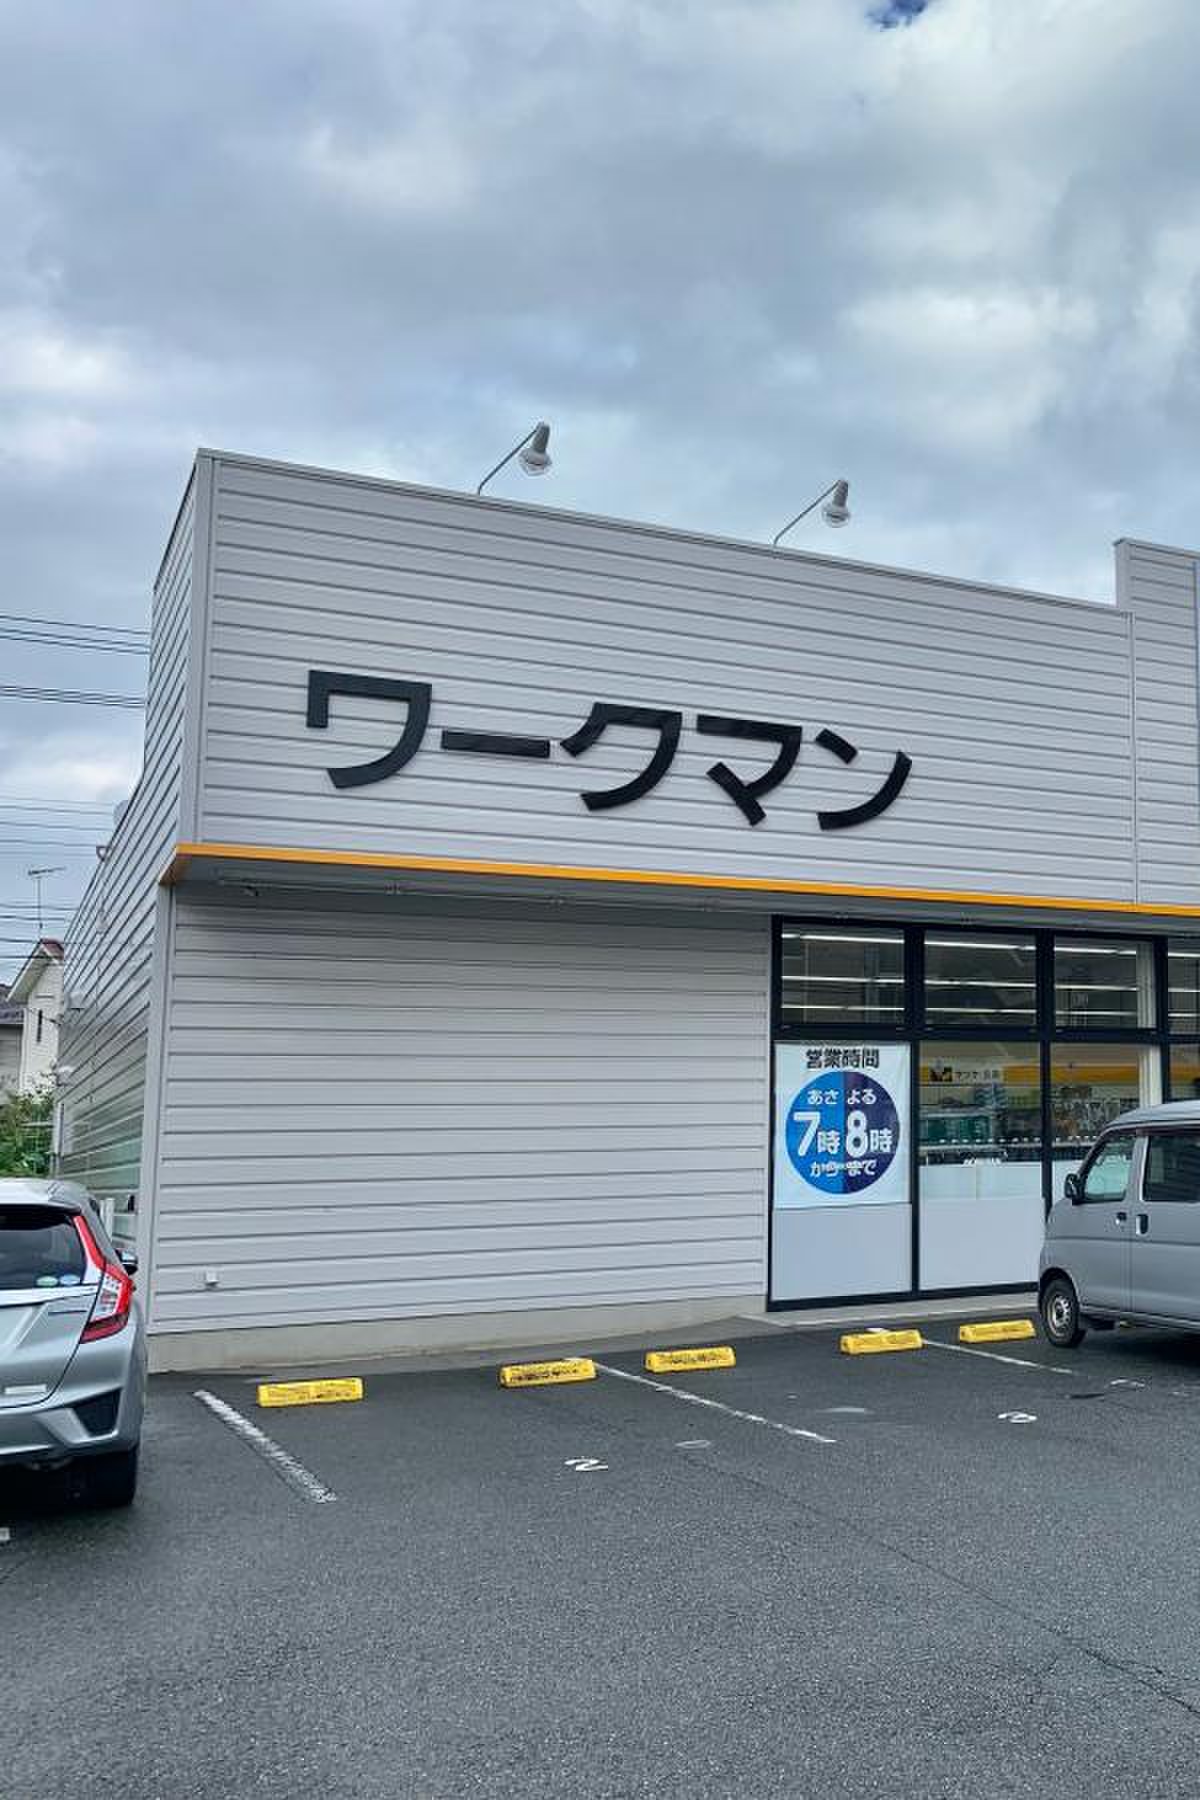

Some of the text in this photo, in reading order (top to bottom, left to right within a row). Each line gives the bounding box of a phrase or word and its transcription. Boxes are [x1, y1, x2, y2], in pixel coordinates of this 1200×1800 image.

[306, 669, 912, 831] ワークマン
[805, 1048, 880, 1069] 営業時間
[807, 1089, 876, 1105] あさ よる
[793, 1110, 892, 1158] 7時 8時
